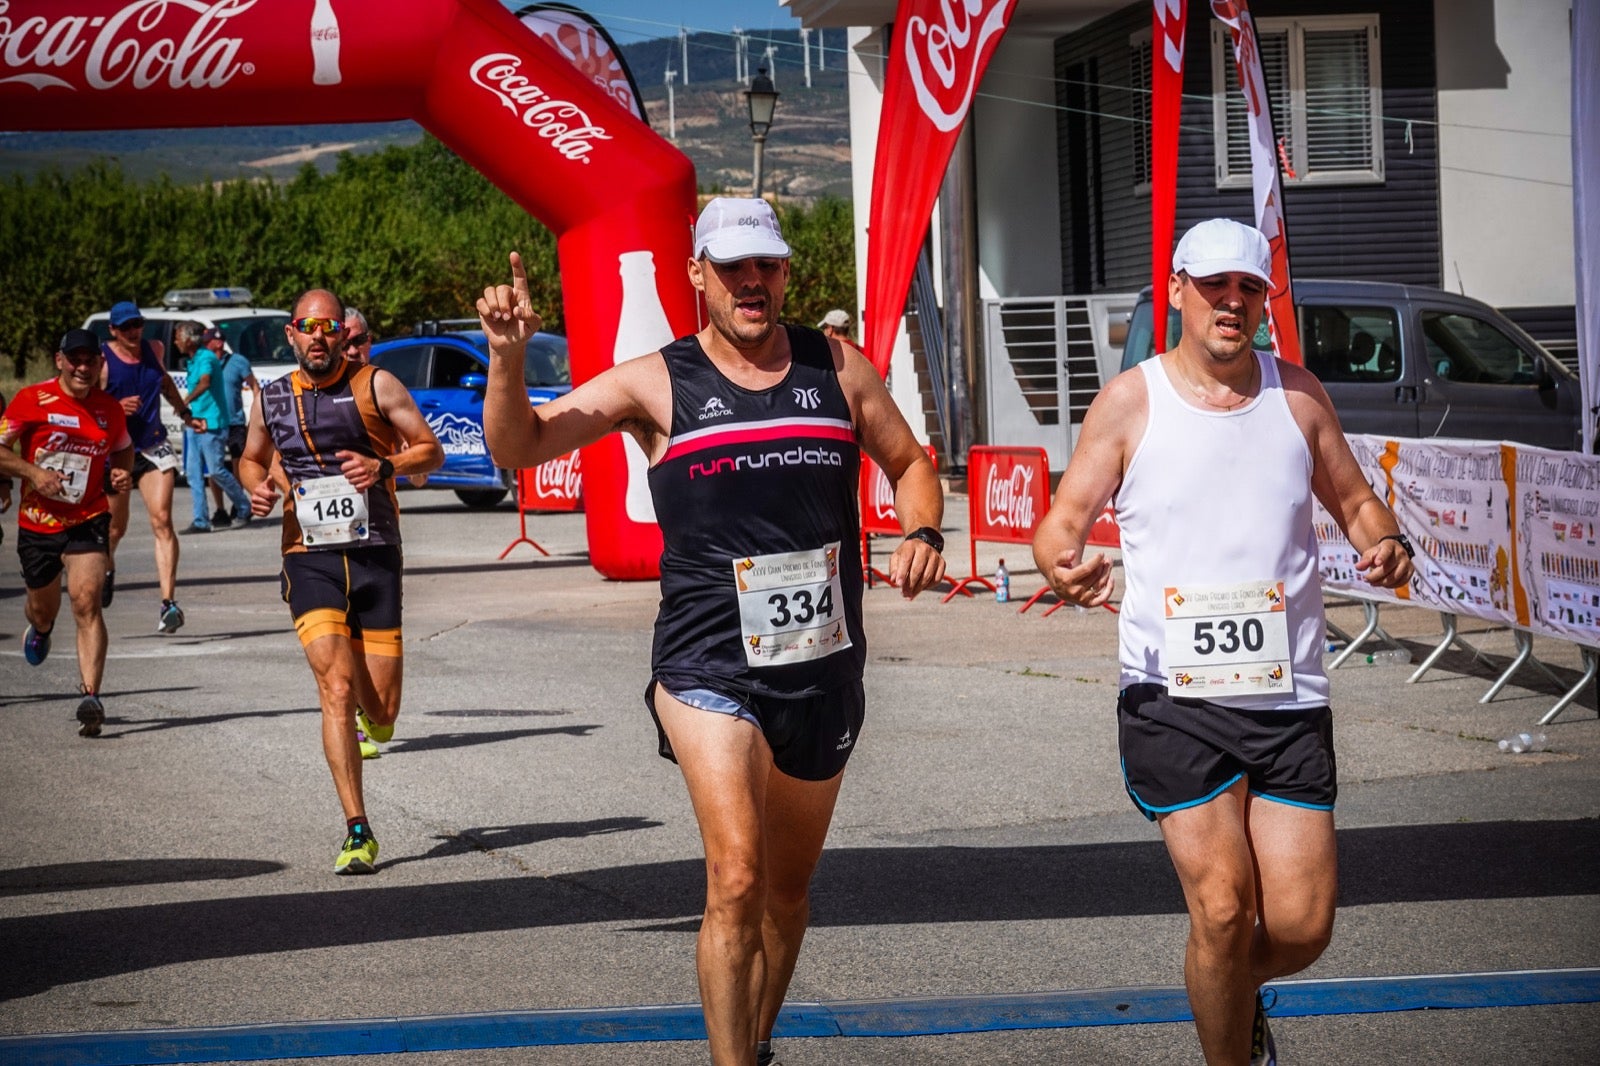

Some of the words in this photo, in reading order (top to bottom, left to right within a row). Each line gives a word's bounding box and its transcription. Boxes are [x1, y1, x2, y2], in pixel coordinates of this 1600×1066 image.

[0, 0, 258, 91] oca-Cola
[469, 53, 613, 164] Coca-Cola
[738, 215, 760, 229] edp
[698, 408, 734, 421] austral
[314, 498, 354, 521] 148
[985, 463, 1034, 528] Coca-Cola
[768, 585, 833, 627] 334
[1194, 618, 1264, 655] 530
